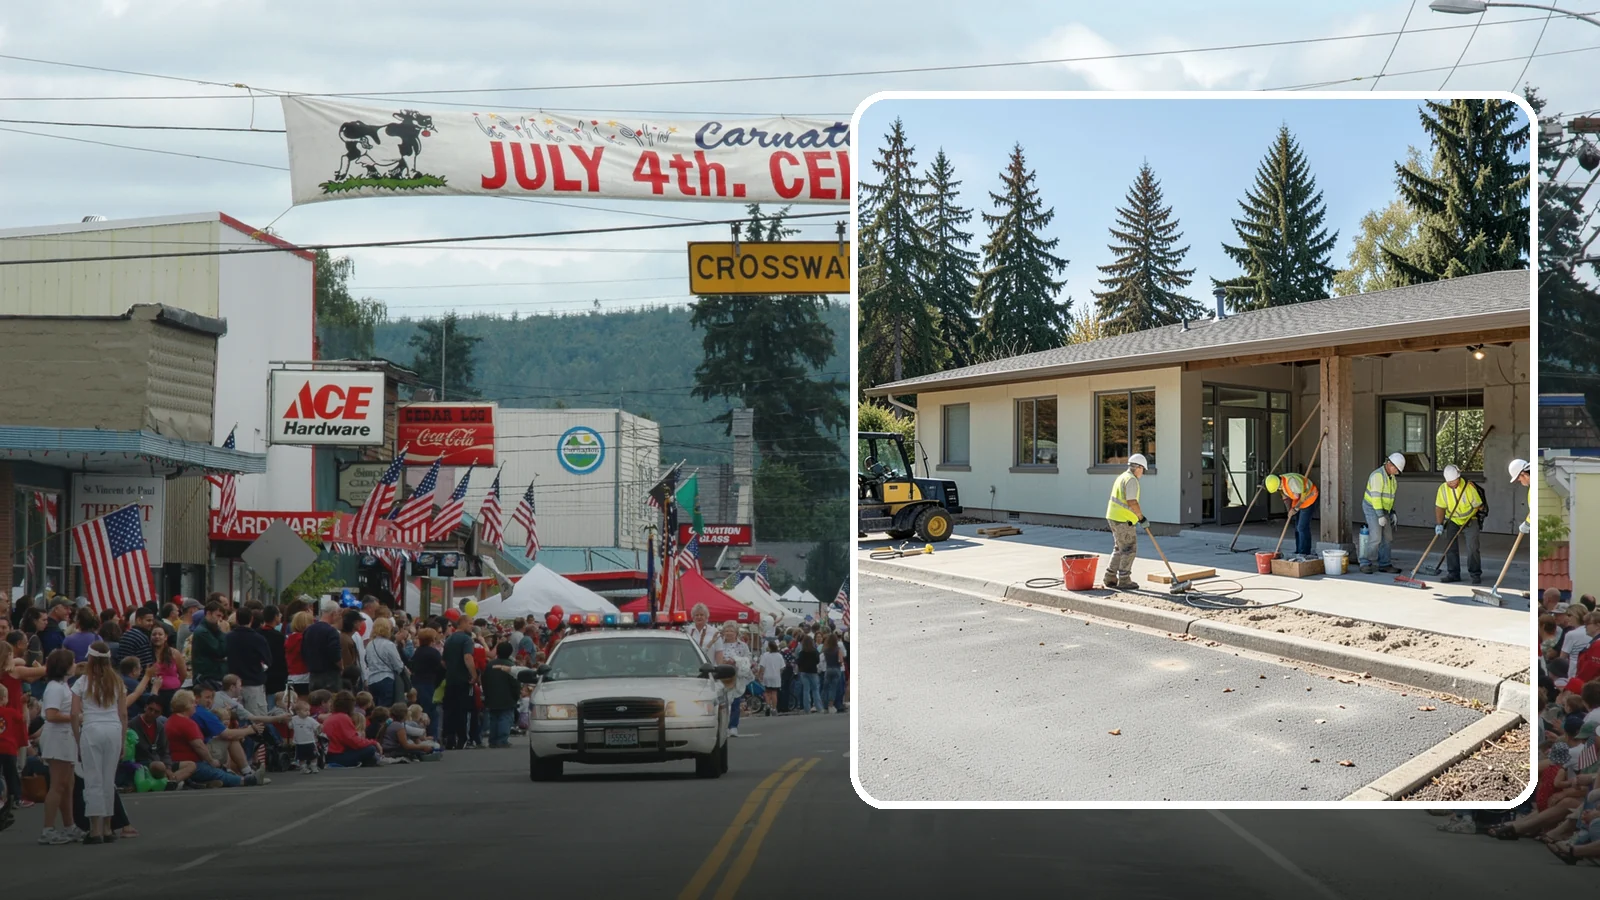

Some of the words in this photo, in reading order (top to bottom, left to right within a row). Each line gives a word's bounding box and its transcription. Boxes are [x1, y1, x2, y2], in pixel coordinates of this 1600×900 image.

[694, 121, 850, 150] Carnat
[481, 141, 605, 193] JULY
[632, 148, 746, 197] 4th.
[697, 254, 850, 280] CROSSWA
[283, 380, 374, 420] ACE
[405, 409, 452, 422] CEDAR
[460, 409, 485, 421] LOG
[283, 420, 371, 437] Hardware
[353, 467, 385, 478] Simpl
[95, 484, 124, 494] Vincent
[126, 485, 135, 494] de
[137, 486, 155, 495] Paul
[688, 526, 741, 535] CRNATION
[698, 535, 730, 543] GLASS
